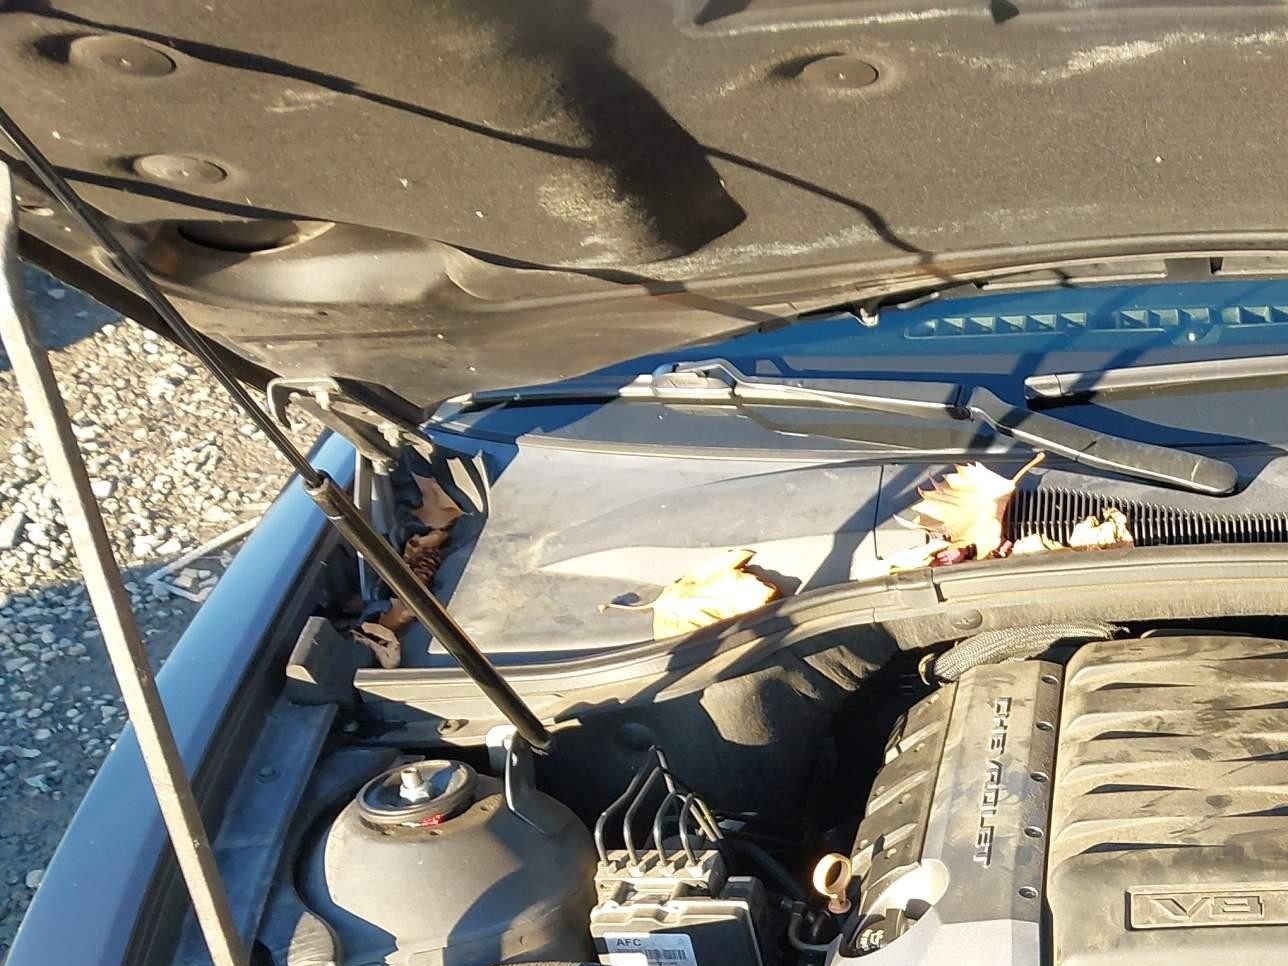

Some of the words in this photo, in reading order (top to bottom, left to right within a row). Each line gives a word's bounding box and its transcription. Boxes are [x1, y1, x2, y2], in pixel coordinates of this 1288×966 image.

[973, 696, 1013, 868] CHEVROLET
[1150, 896, 1265, 922] V8
[616, 938, 642, 947] AFC
